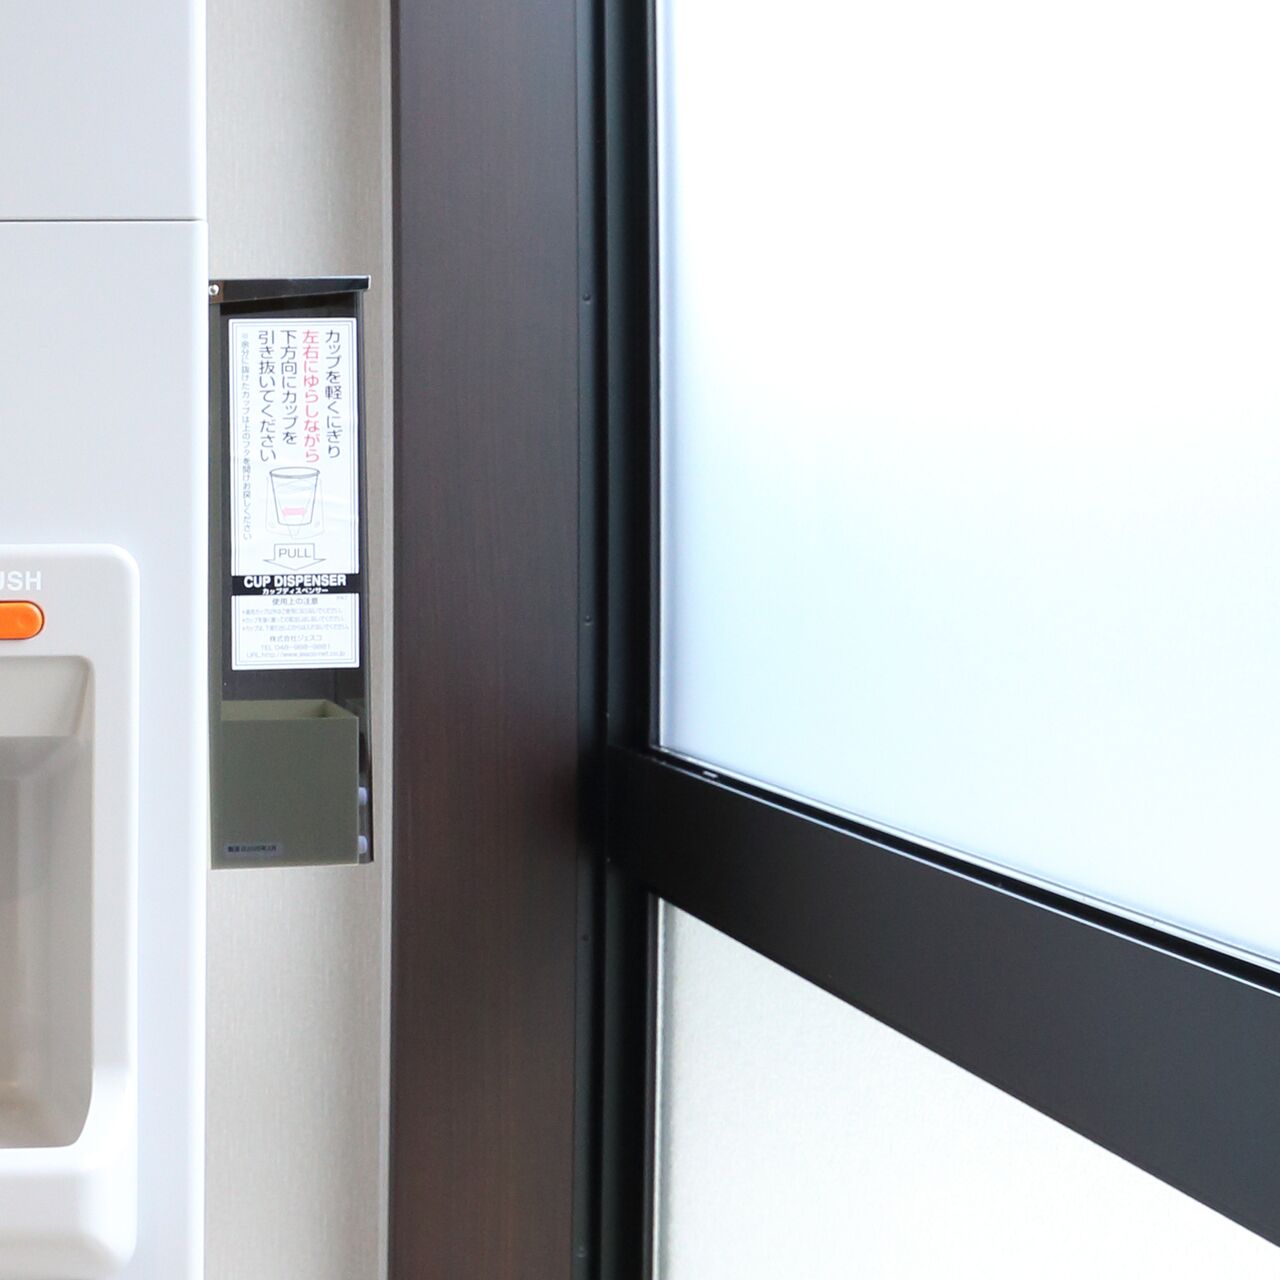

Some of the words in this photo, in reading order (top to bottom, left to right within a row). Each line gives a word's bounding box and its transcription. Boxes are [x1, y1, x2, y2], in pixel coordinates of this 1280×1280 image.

[258, 329, 277, 462] 引き抜いてください
[280, 329, 299, 446] 下方向にカップを
[302, 329, 321, 463] 左右にゆらしながら
[324, 329, 343, 460] カップを軽くにぎり
[243, 574, 271, 589] CUP
[274, 573, 347, 588] DISPENSER
[278, 547, 312, 559] PULL
[261, 587, 329, 596] カップディスペンサー
[272, 597, 319, 607] 使用上の注意
